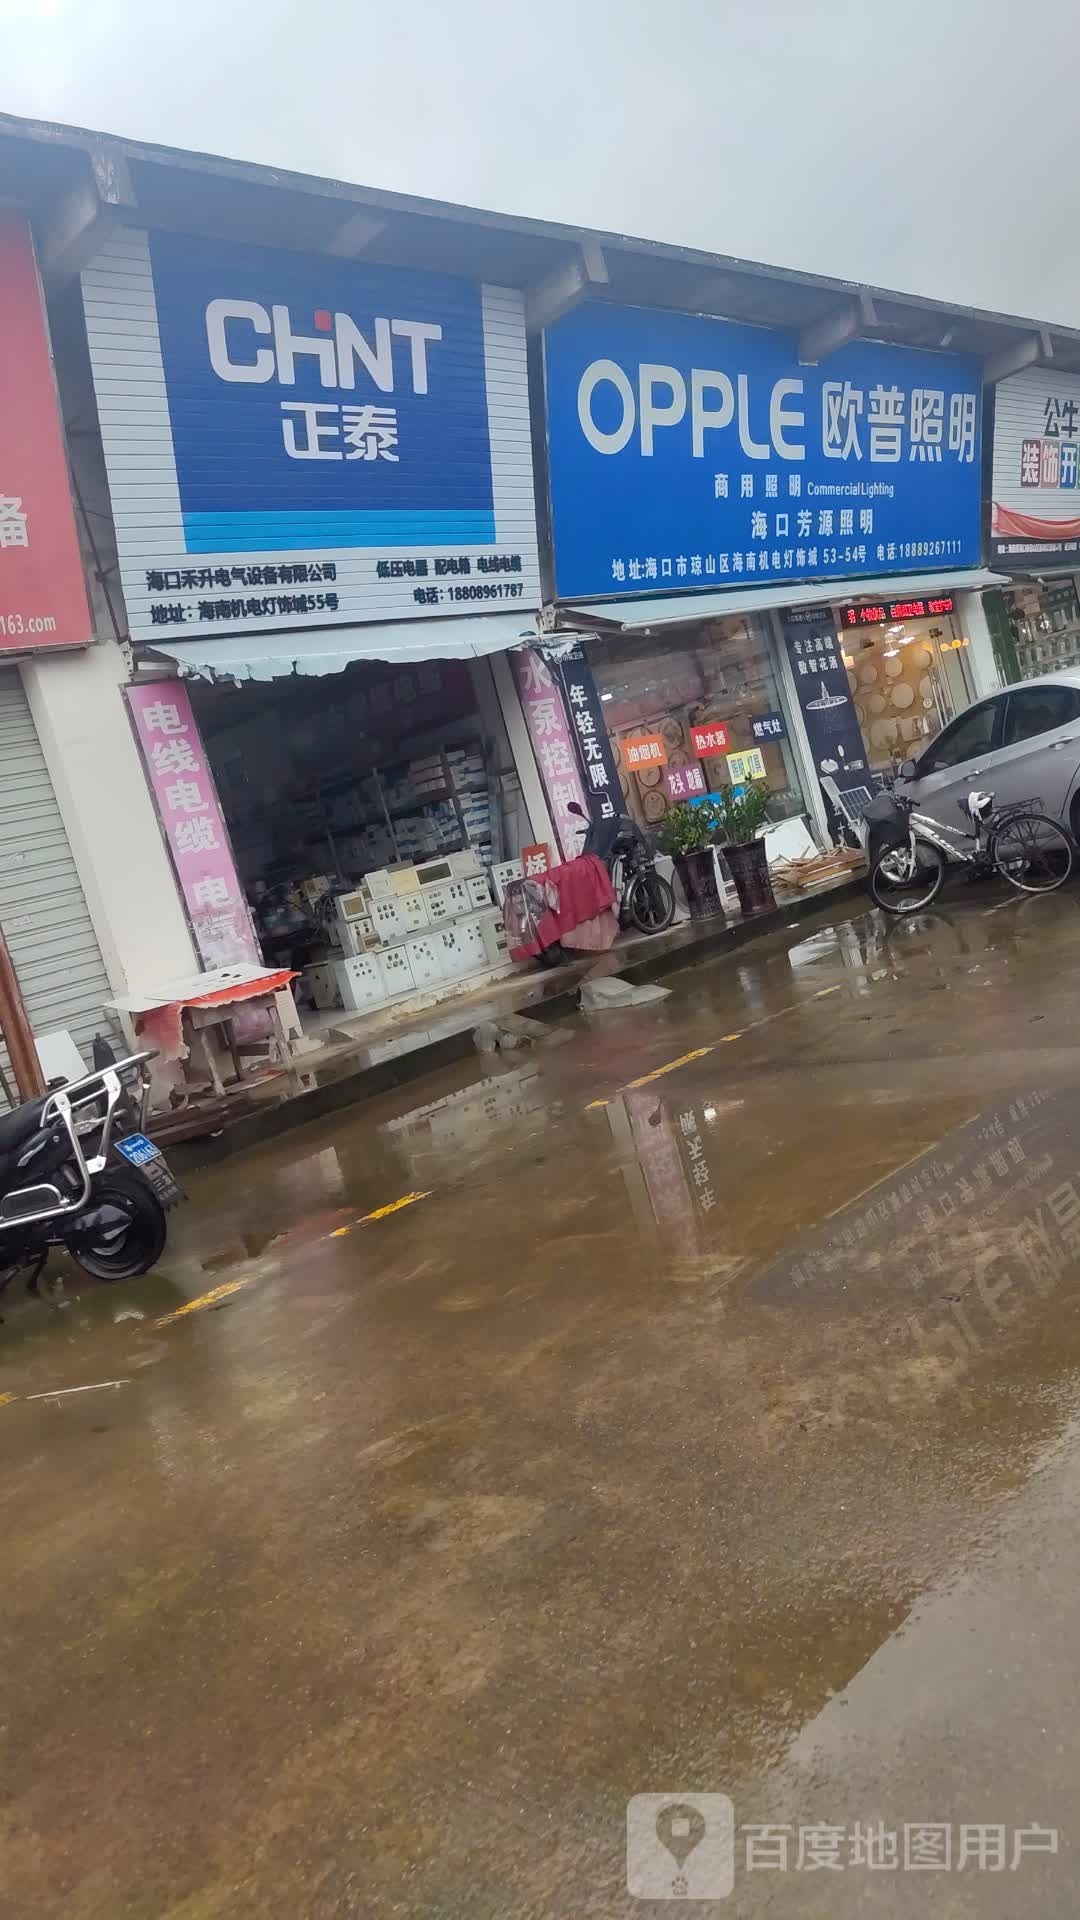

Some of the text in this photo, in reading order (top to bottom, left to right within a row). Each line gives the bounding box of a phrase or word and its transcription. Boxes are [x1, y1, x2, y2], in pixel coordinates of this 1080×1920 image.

[577, 359, 976, 463] OPPLE 欧普照明
[281, 401, 399, 462] 正泰
[1022, 443, 1080, 484] 装饰开
[714, 473, 894, 498] 商用照明 Commercial Lighting
[751, 509, 873, 540] 海口芳源照明
[146, 563, 336, 591] 海口禾升电气设备有限公司
[570, 684, 609, 788] 年轻无限
[626, 742, 663, 763] 油烟机
[695, 731, 726, 751] 热水器
[142, 701, 220, 854] 电线电缆
